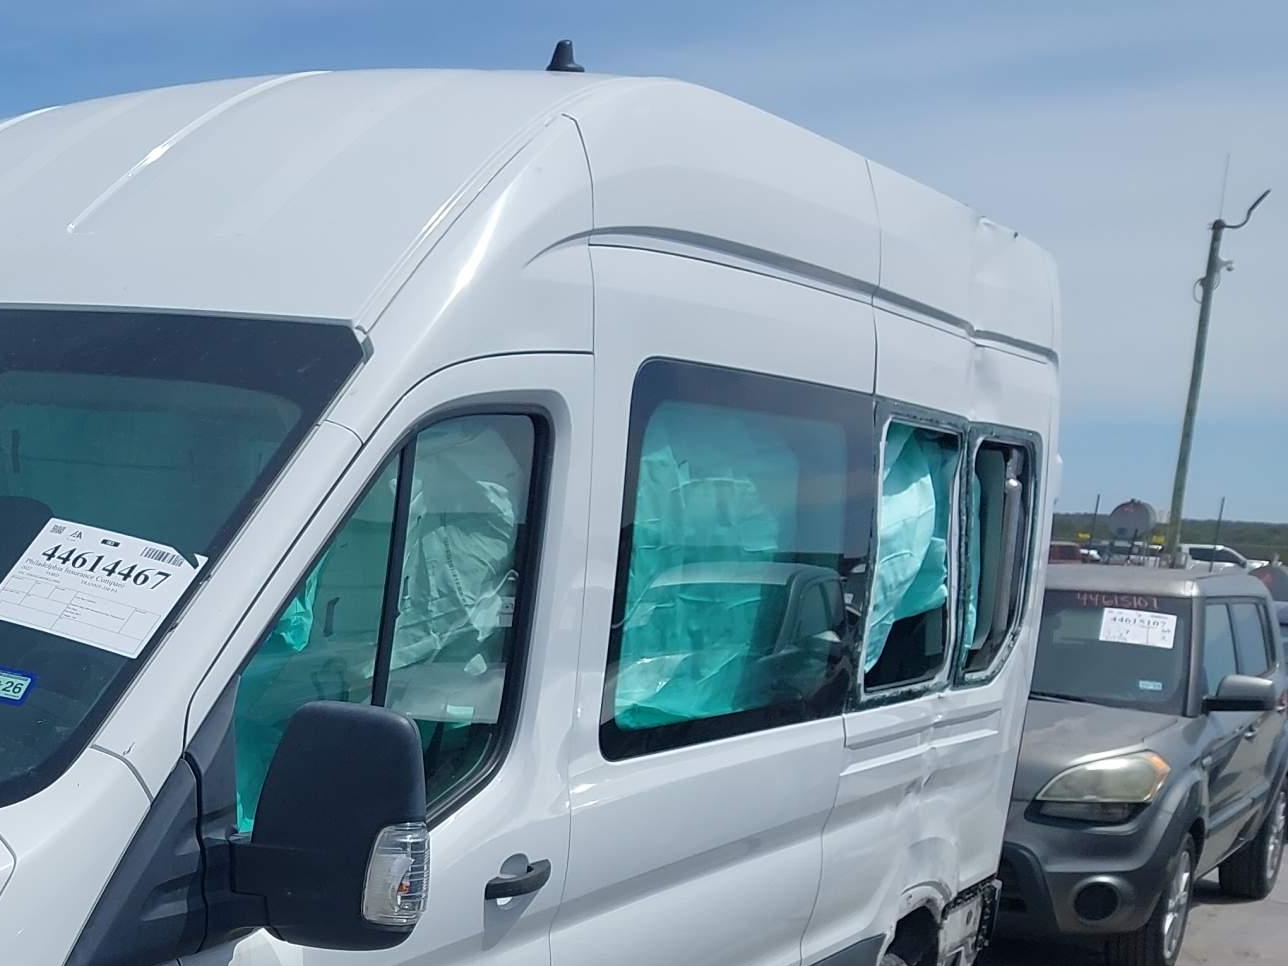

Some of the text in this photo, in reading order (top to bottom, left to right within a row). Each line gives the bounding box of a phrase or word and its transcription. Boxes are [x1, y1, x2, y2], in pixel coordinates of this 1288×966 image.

[41, 543, 172, 591] 44614467
[64, 567, 96, 581] Insurance
[2, 680, 24, 695] 26
